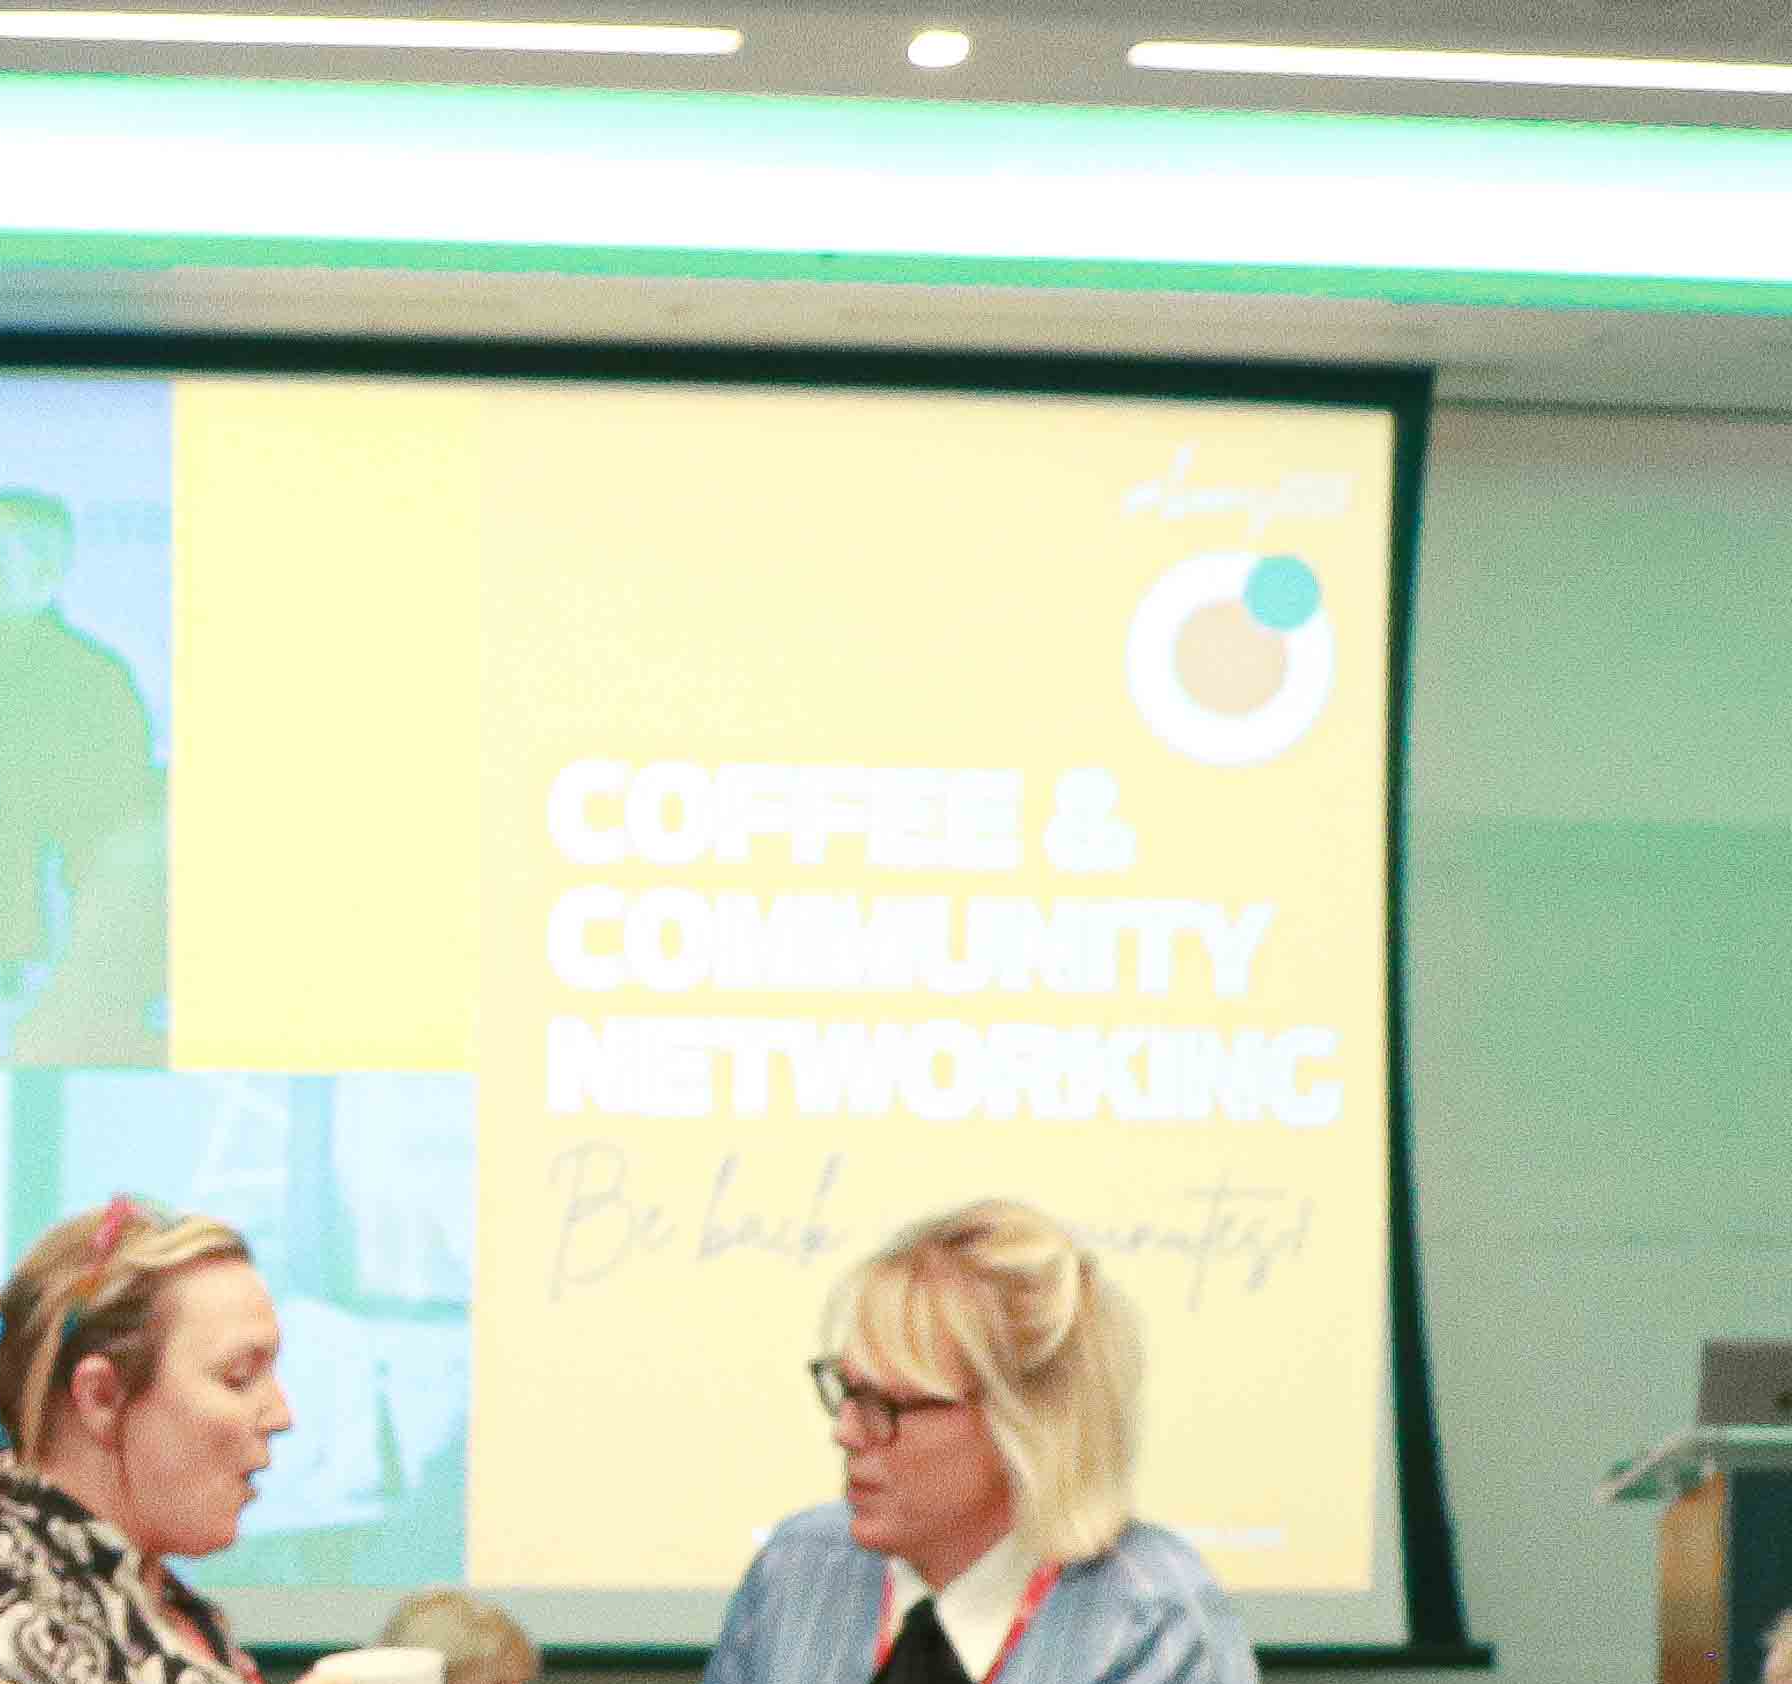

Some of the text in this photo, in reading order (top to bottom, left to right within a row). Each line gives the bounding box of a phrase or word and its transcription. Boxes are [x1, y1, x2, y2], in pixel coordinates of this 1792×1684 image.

[546, 759, 1137, 872] COFFEE &
[546, 884, 1277, 999] COMMUNITY
[546, 1014, 1345, 1128] NETWORKING
[545, 1138, 678, 1304] Be
[695, 1150, 850, 1268] back
